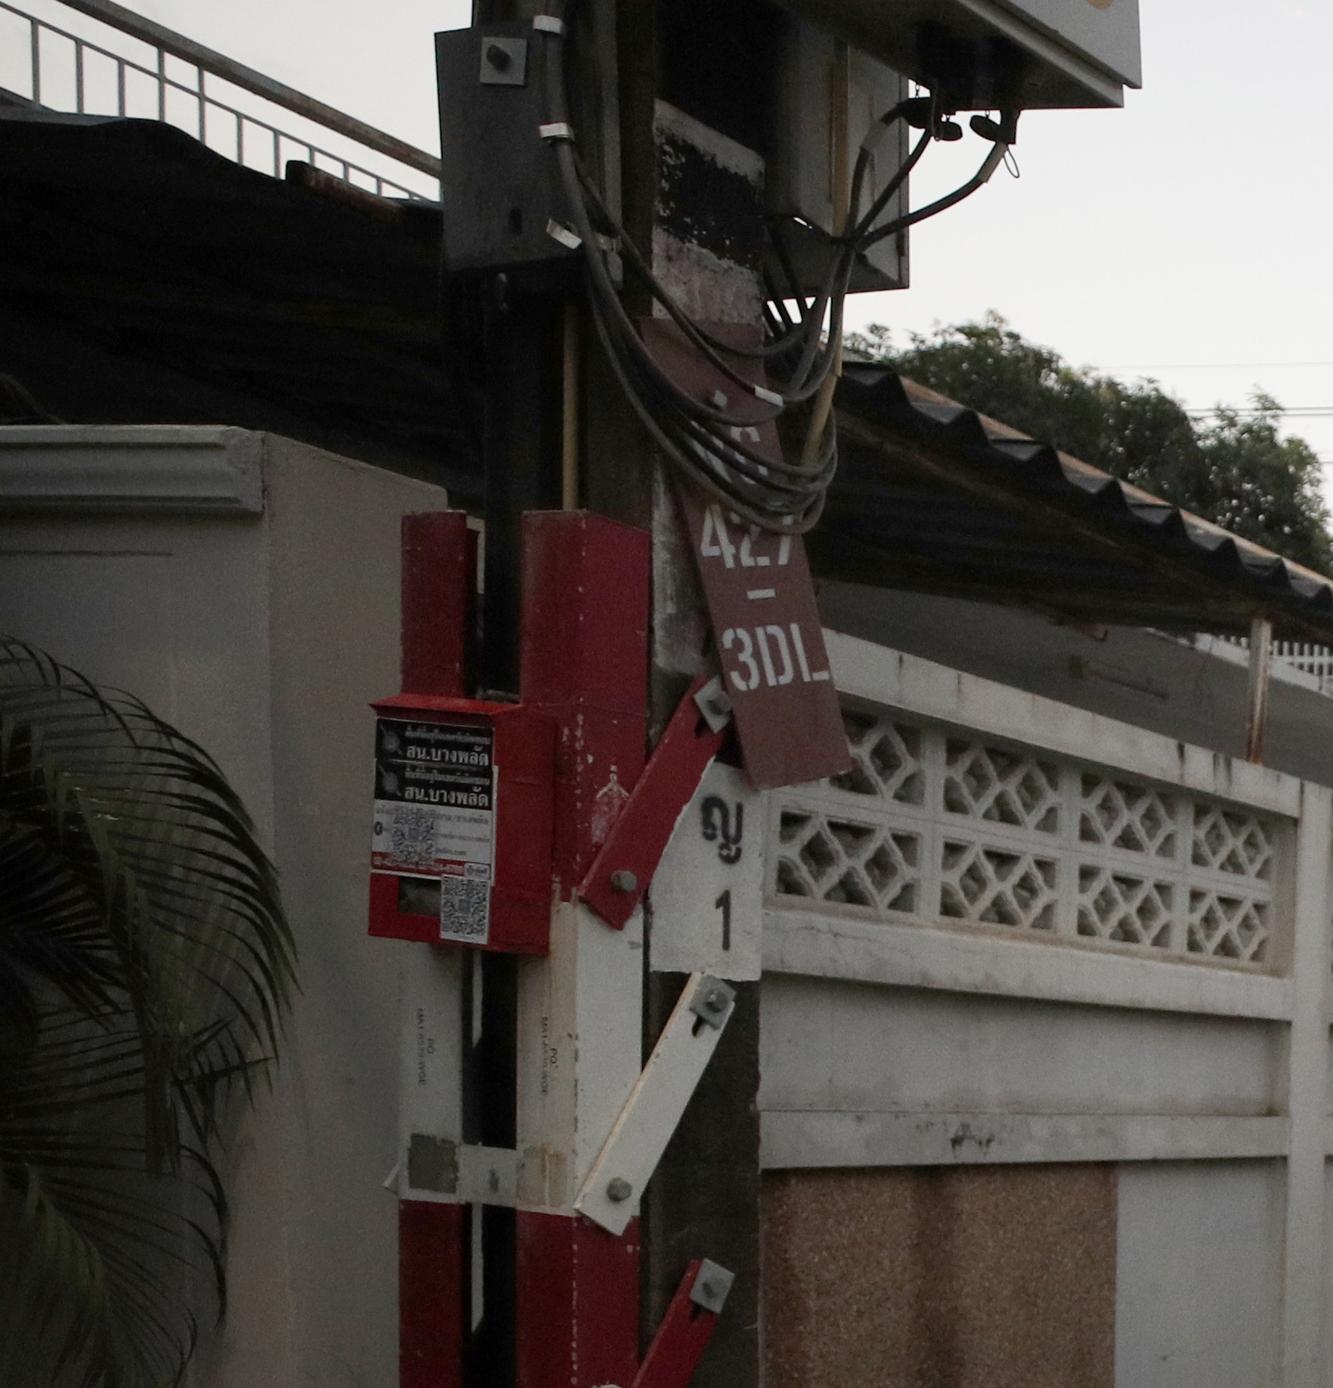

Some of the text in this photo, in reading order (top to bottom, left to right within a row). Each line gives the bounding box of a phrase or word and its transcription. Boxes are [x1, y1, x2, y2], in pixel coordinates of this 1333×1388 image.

[720, 621, 829, 692] 3DL
[405, 744, 490, 767] สน.บางพลัด
[403, 785, 490, 808] สน.บางพลัด
[714, 888, 732, 951] 1
